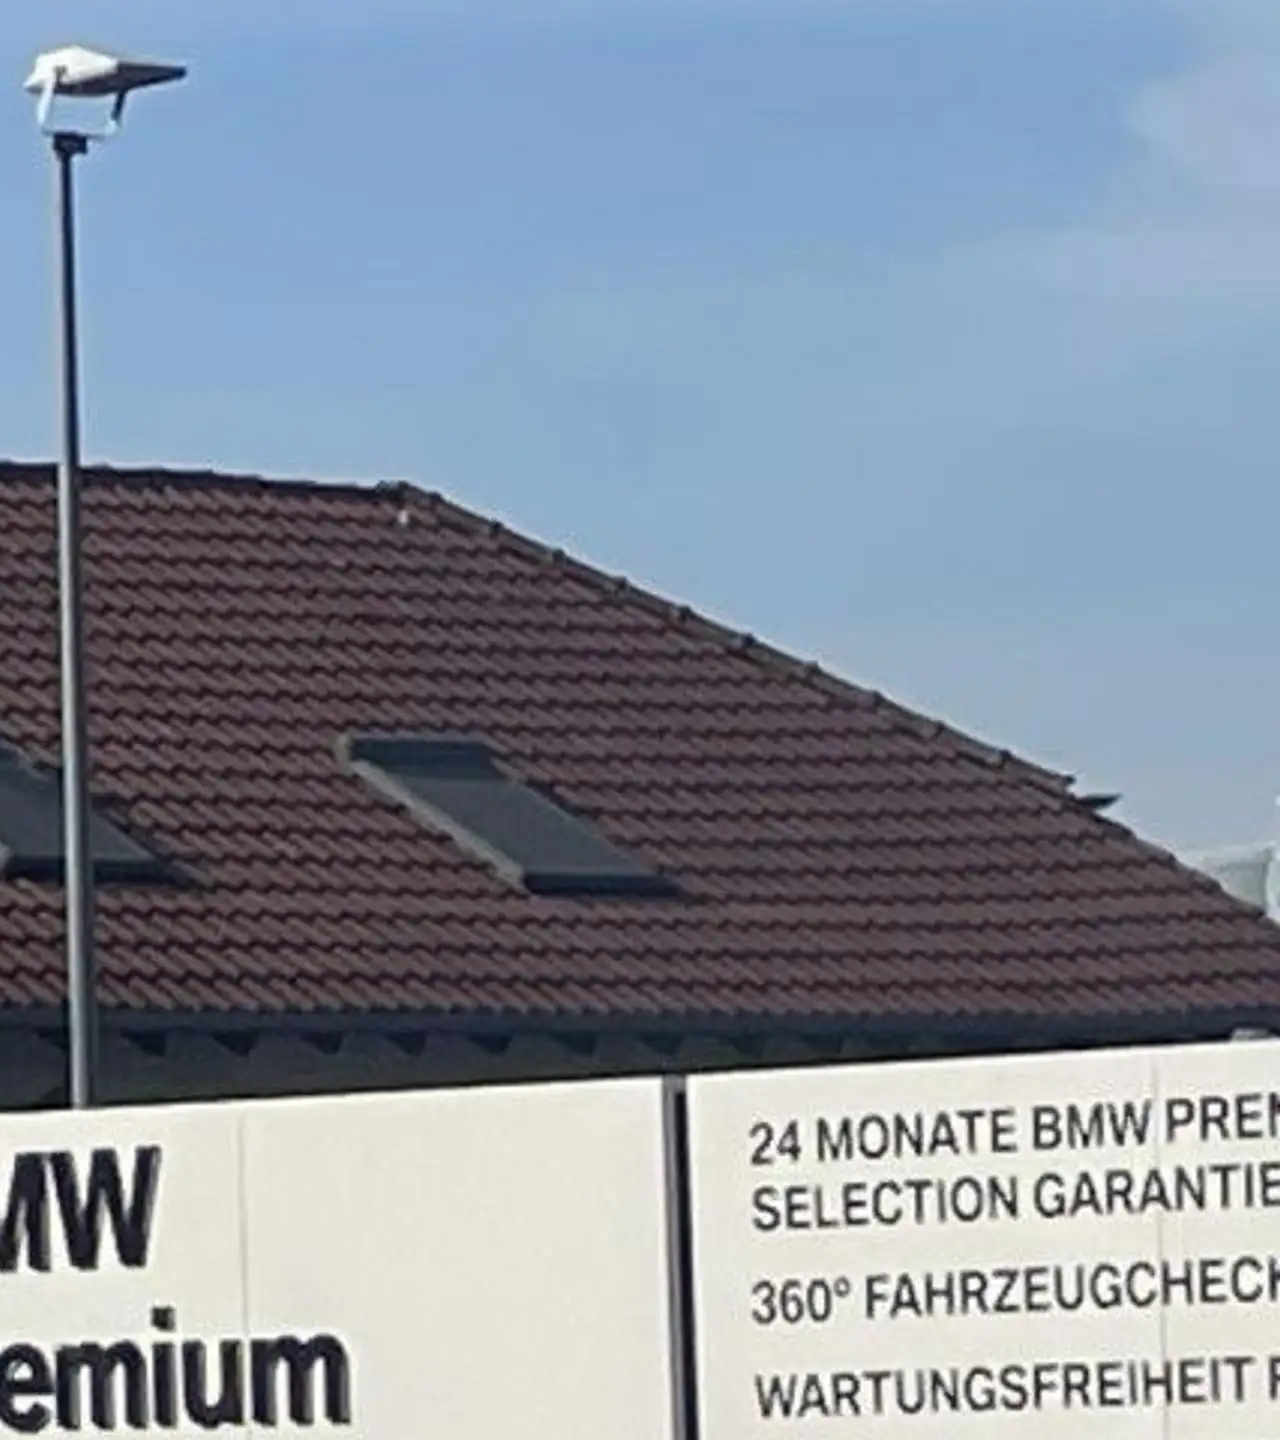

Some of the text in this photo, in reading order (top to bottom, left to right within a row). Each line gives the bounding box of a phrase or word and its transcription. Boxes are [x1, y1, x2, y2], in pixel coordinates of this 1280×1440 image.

[750, 1121, 802, 1165] 24
[816, 1108, 1018, 1162] MONATE
[1032, 1100, 1152, 1151] BMW
[752, 1161, 1280, 1232] SELECTION GARANTIE
[751, 1277, 850, 1325] 360°
[754, 1357, 1254, 1418] WARTUNGSFREIHEIT
